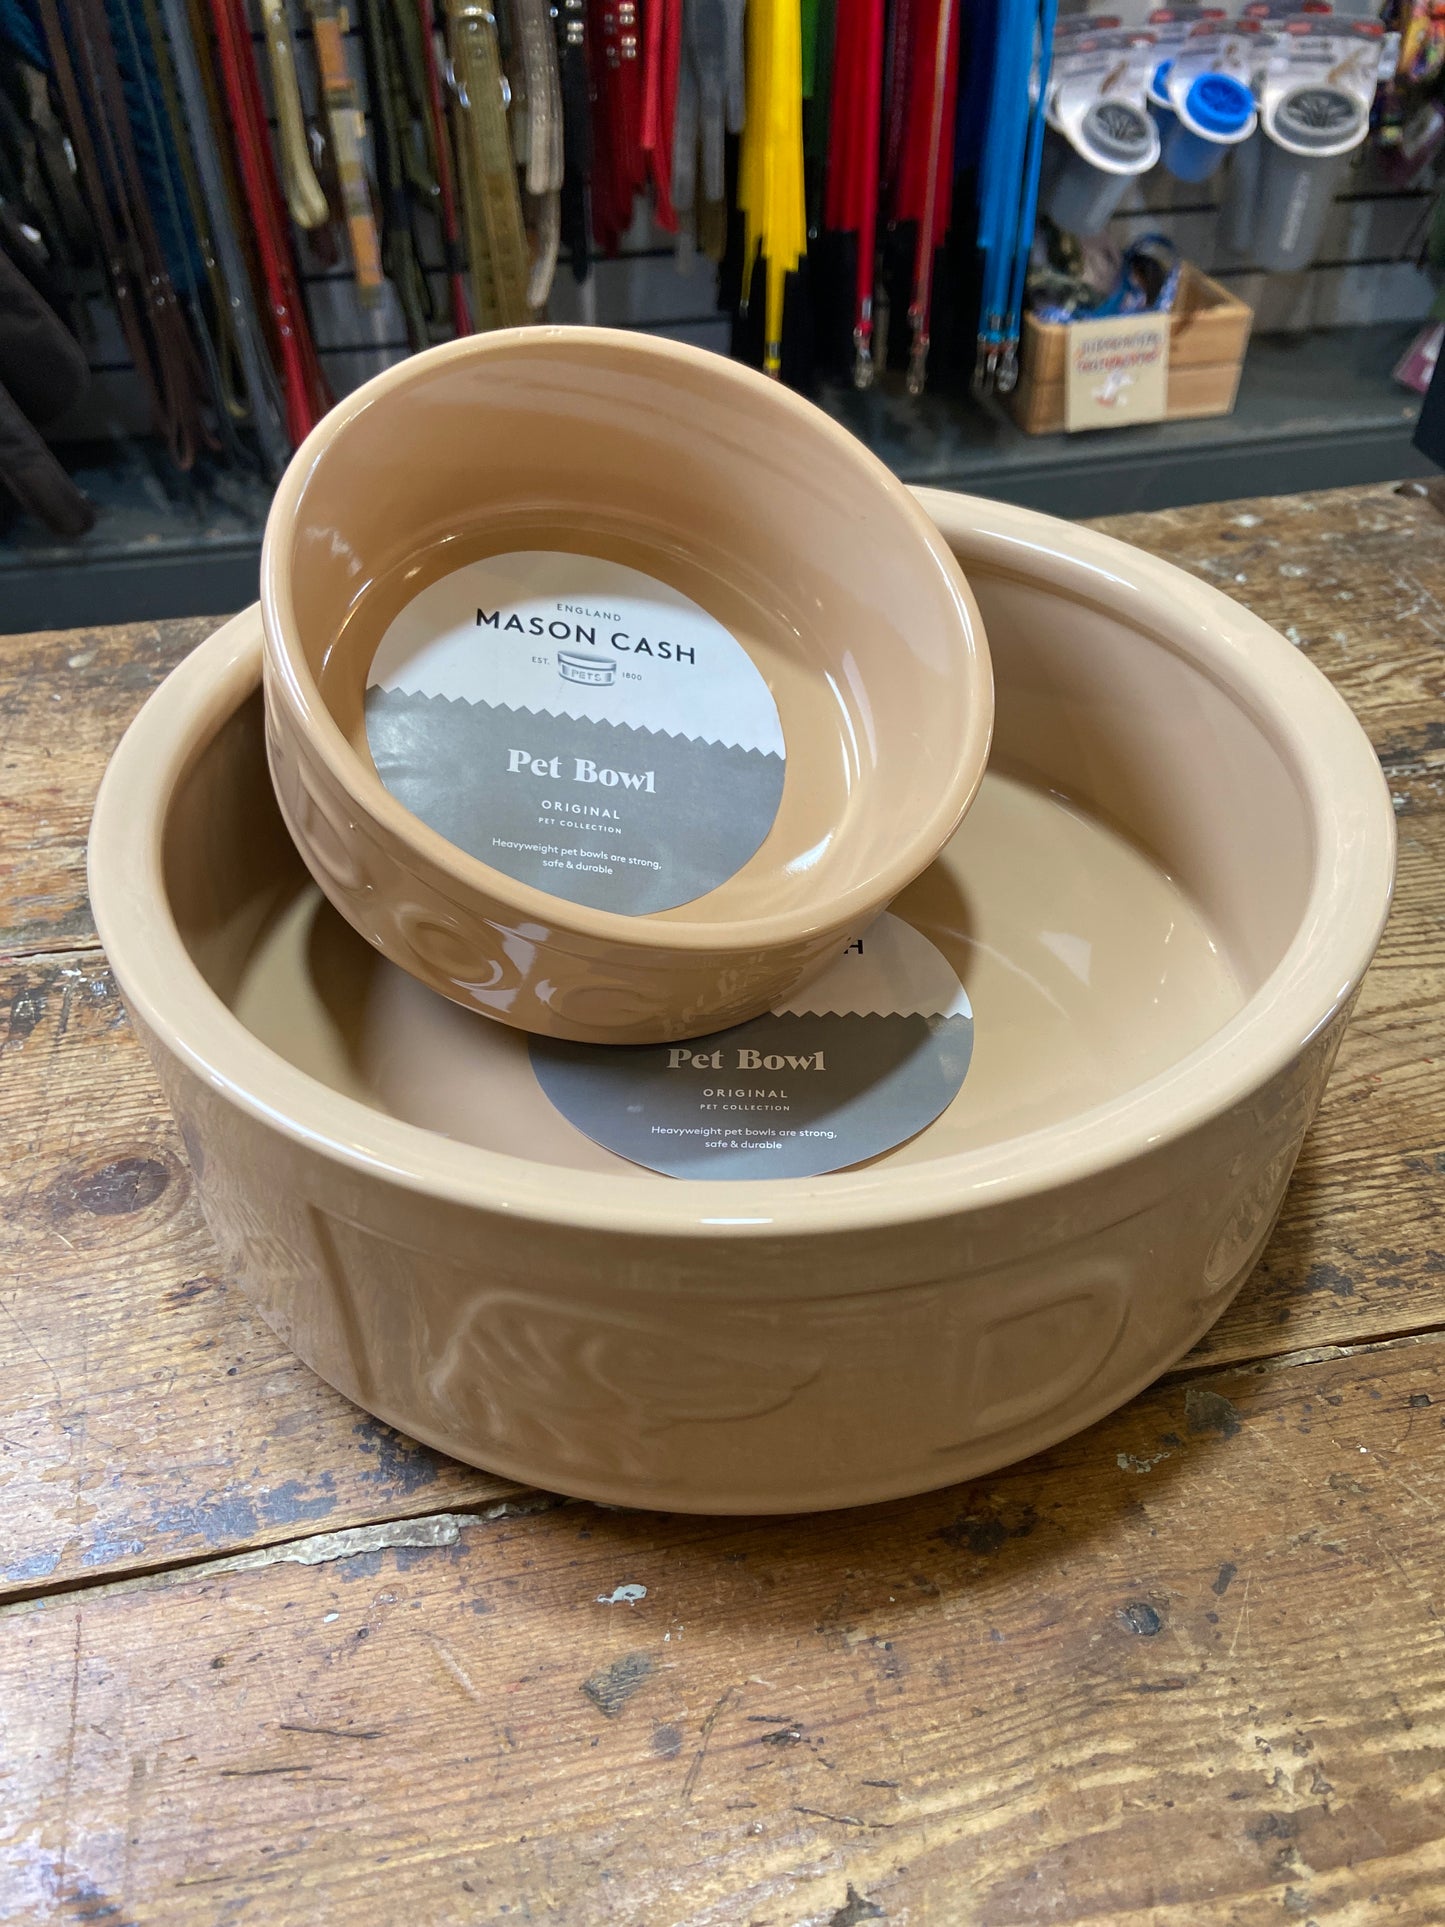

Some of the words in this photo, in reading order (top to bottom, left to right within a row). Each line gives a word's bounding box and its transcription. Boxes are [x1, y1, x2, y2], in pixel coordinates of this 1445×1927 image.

[556, 603, 622, 622] ENGLAND
[475, 608, 597, 646] MASON
[611, 632, 696, 665] CASH
[531, 656, 550, 665] EST.
[570, 669, 603, 683] PETS
[622, 672, 642, 681] 1800
[506, 748, 563, 779] Pet
[573, 757, 657, 793] Bowl
[541, 800, 621, 820] ORIGINAL
[538, 817, 556, 825] PET
[559, 819, 622, 835] COLLECTION
[492, 837, 559, 855] Heavyweight
[560, 846, 578, 857] pet
[580, 848, 609, 860] bowls
[610, 854, 627, 863] are
[628, 855, 663, 870] strong,
[542, 858, 564, 869] safe
[566, 860, 574, 869] &
[575, 860, 614, 875] durable
[666, 1048, 725, 1070] Pet
[736, 1049, 827, 1072] Bowl
[702, 1088, 788, 1099] ORIGINAL
[699, 1103, 719, 1111] PET
[722, 1104, 791, 1112] COLLECTION
[651, 1125, 722, 1137] Heavyweight
[724, 1127, 743, 1137] pet
[745, 1127, 777, 1137] bowls
[778, 1129, 797, 1137] are
[798, 1128, 838, 1140] strong,
[704, 1139, 728, 1149] safe
[730, 1140, 739, 1149] &
[740, 1139, 783, 1150] durable
